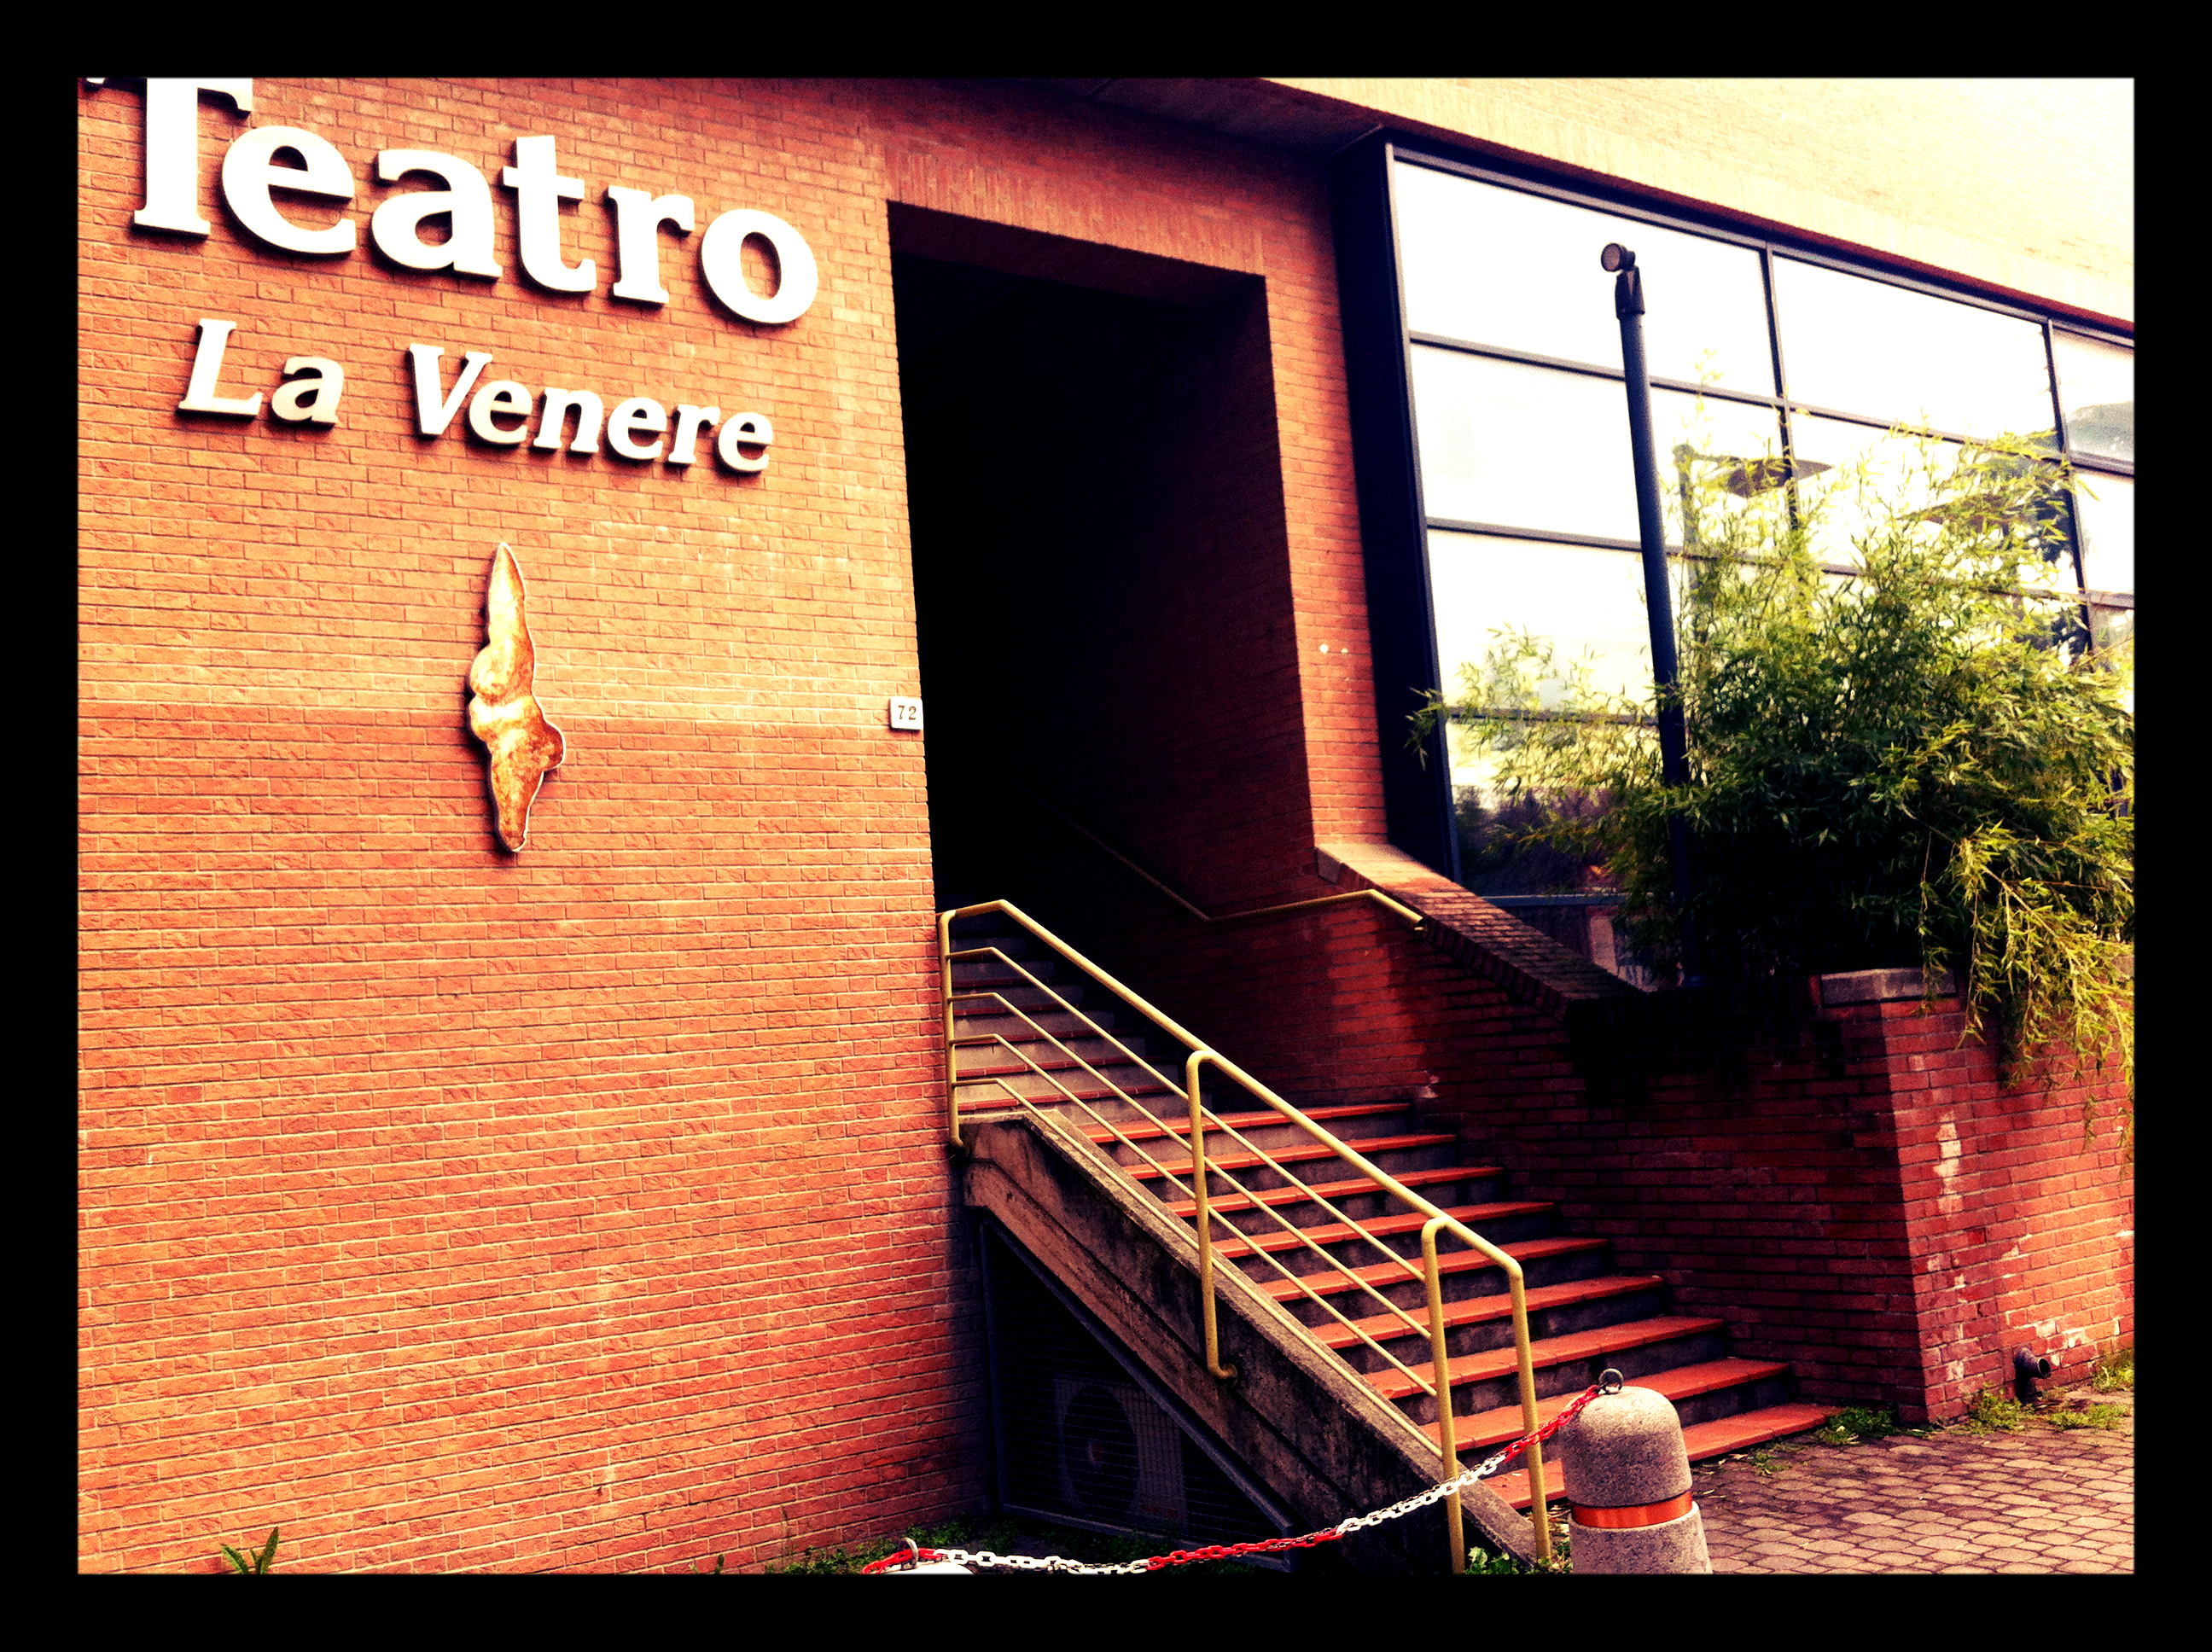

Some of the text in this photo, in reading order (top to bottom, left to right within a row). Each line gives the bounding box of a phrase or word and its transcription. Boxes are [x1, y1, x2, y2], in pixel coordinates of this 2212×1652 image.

[87, 78, 819, 325] Teatro
[178, 318, 774, 475] La Venere
[897, 705, 917, 721] 72
